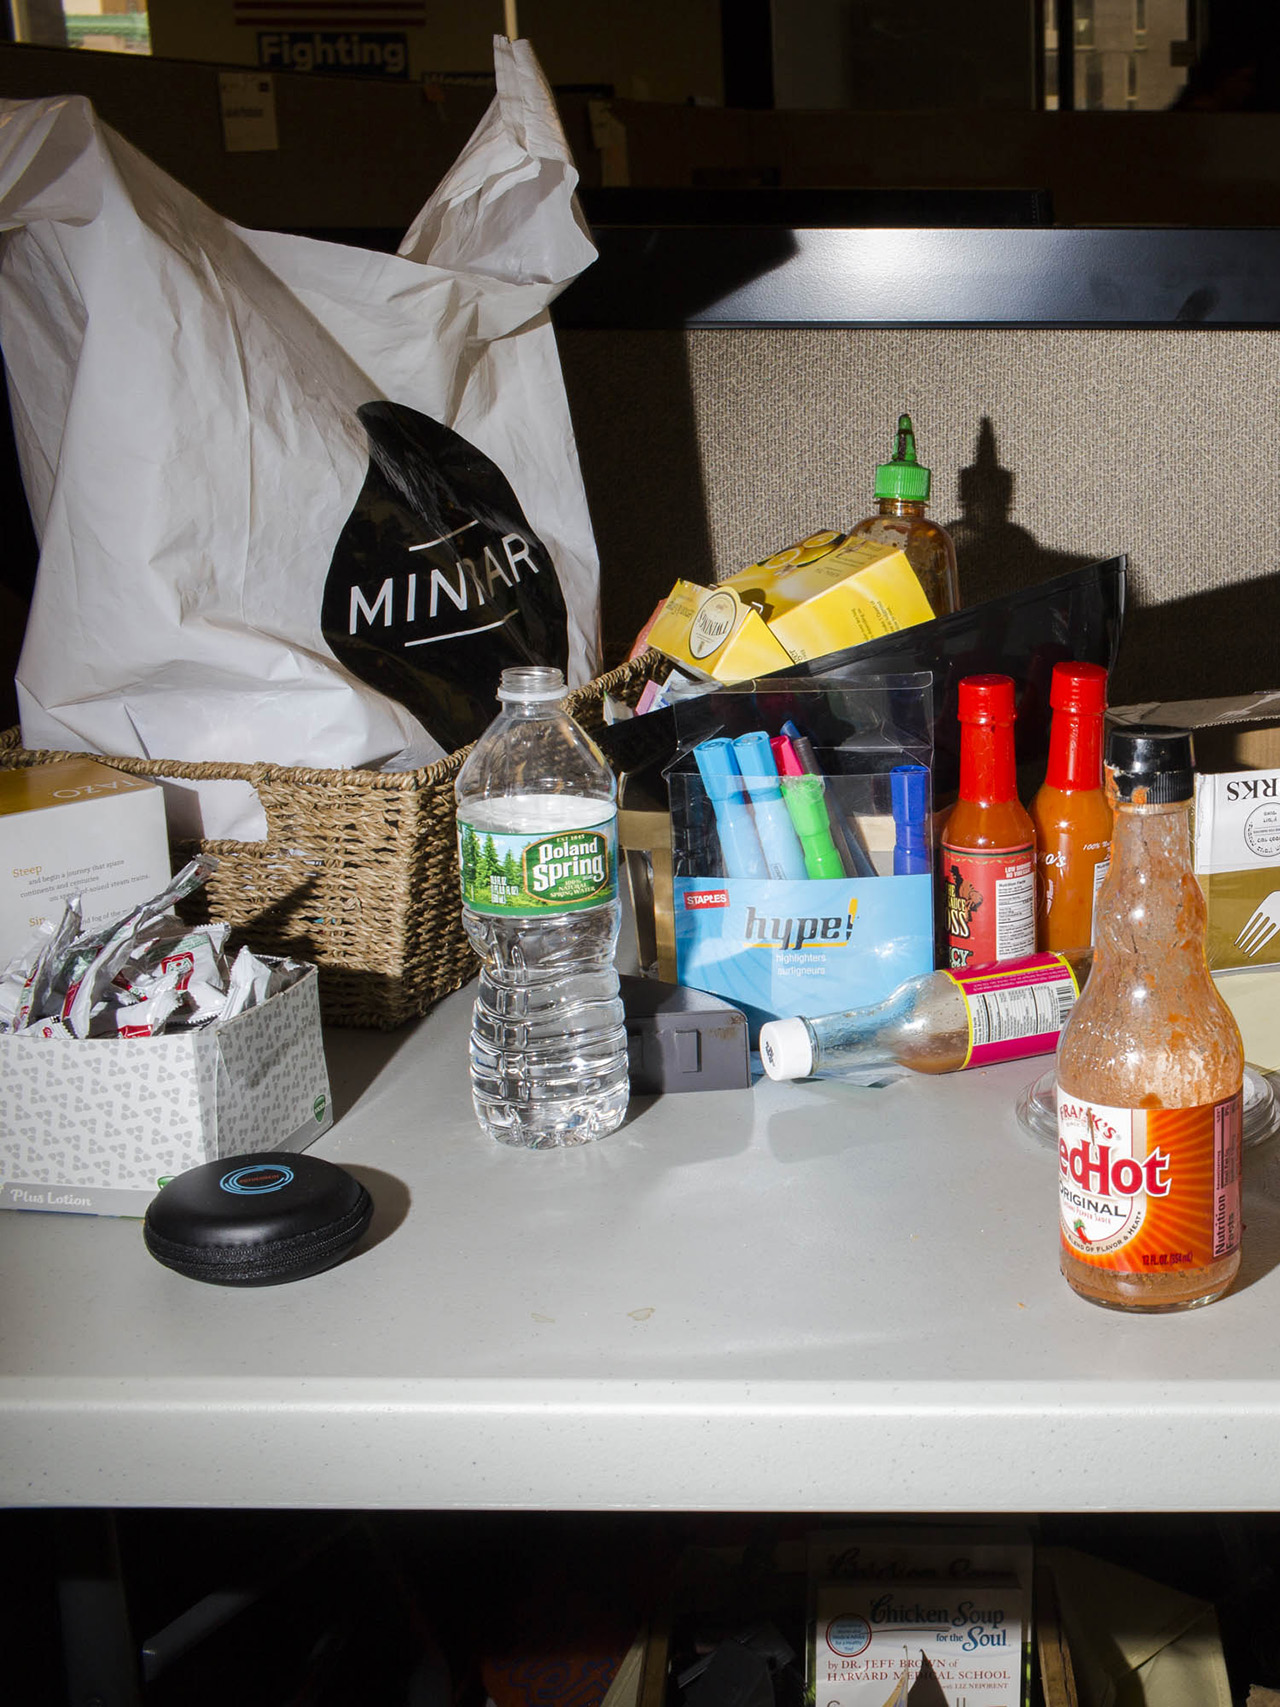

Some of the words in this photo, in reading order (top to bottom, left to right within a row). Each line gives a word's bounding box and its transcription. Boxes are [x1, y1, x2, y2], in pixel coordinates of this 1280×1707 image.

[260, 34, 406, 73] Fighting
[53, 780, 142, 799] TAZO
[538, 837, 598, 864] Poland
[12, 864, 43, 878] Steep
[29, 877, 41, 886] and
[42, 873, 60, 885] begin
[66, 867, 91, 879] journey
[92, 863, 105, 872] that
[532, 855, 605, 892] Spring
[20, 887, 55, 898] continents
[56, 882, 69, 890] and
[687, 893, 727, 905] STAPLES
[745, 897, 858, 951] hype!
[776, 952, 827, 964] highlighters
[1058, 1136, 1172, 1198] edHot
[10, 1187, 43, 1206] Plus
[47, 1189, 93, 1208] Lotion
[1215, 1194, 1226, 1255] Nutrition
[870, 1593, 949, 1624] Chicken
[952, 1601, 1004, 1628] Soup
[936, 1633, 948, 1642] for
[949, 1633, 963, 1642] the
[962, 1626, 1006, 1652] Soul
[828, 1660, 839, 1671] by
[841, 1659, 861, 1669] DR.
[863, 1659, 895, 1671] JEFF
[948, 1658, 959, 1668] of
[827, 1671, 888, 1682] HARVARD
[958, 1669, 1011, 1680] SCHOOL
[967, 1682, 1008, 1690] NEPORENT
